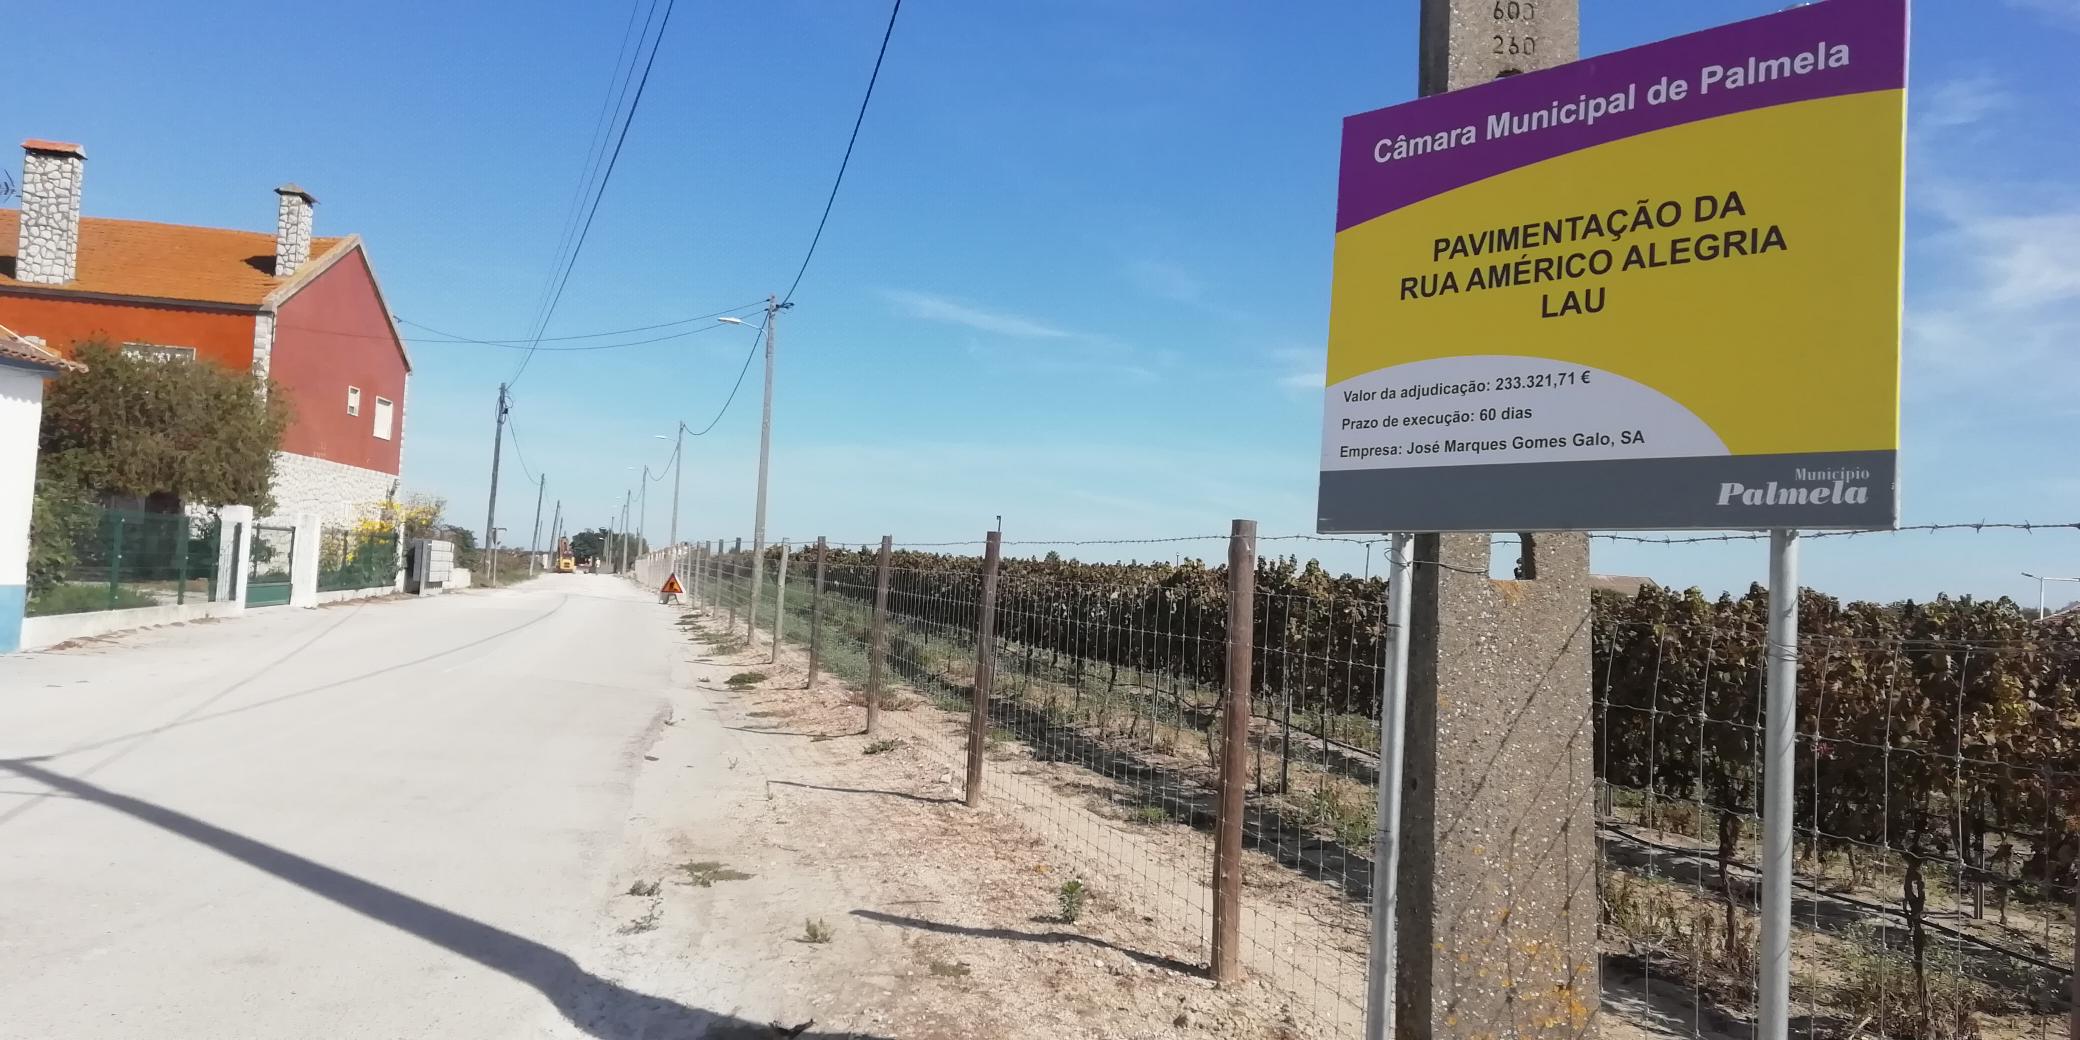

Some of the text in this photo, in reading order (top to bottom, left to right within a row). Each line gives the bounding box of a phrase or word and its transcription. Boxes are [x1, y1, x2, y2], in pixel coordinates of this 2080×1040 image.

[1493, 35, 1535, 55] 260
[1373, 40, 1851, 163] Câmara Municipal de Palmela
[1433, 190, 1746, 262] PAVIMENTAÇÃO DA
[1400, 224, 1788, 301] RUA AMÉRICO ALEGRIA
[1541, 287, 1606, 319] LAU
[1343, 370, 1591, 403] Valor da adjudicação: 233.321,71 €
[1341, 406, 1533, 431] Prazo de execução: 60 dias
[1339, 431, 1645, 461] Empresa: José Marques Gomes Galo, SA
[1794, 466, 1871, 484] Município
[1716, 480, 1869, 507] Palmela
